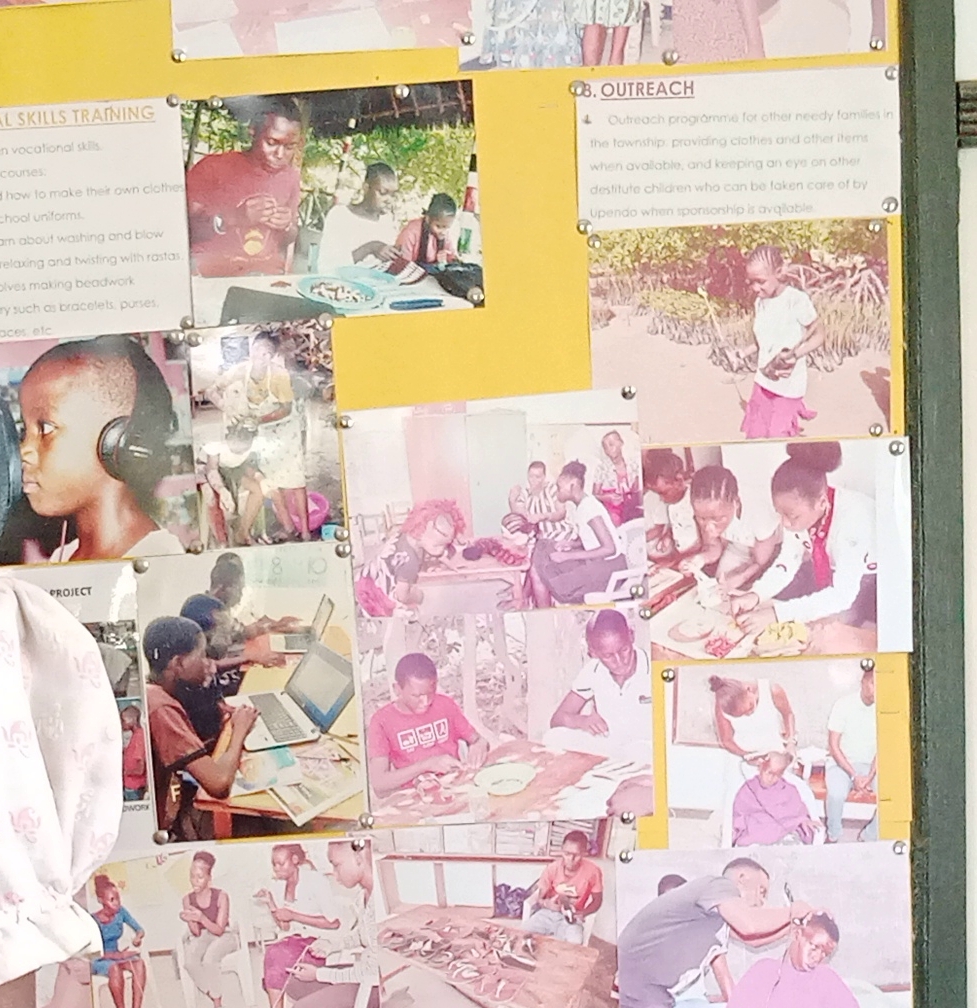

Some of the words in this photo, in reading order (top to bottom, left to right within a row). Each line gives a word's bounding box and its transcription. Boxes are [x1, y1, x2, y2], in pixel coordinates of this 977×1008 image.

[601, 81, 694, 97] OUTREACH
[18, 110, 66, 126] SKILLS
[72, 106, 155, 122] TRAINING
[608, 114, 664, 125] Outreach
[743, 112, 757, 122] for
[761, 111, 791, 121] other
[796, 110, 833, 122] needy
[837, 109, 880, 120] families
[884, 109, 893, 119] in
[590, 138, 609, 148] the
[672, 135, 727, 149] providing
[731, 135, 772, 146] clothes
[776, 134, 800, 145] and
[803, 134, 833, 144] other
[837, 133, 868, 143] items
[13, 143, 74, 155] vocational
[590, 161, 622, 171] when
[687, 159, 711, 169] and
[714, 158, 763, 170] keeping
[766, 160, 782, 168] an
[786, 158, 807, 169] eye
[811, 158, 826, 167] on
[829, 156, 860, 166] other
[6, 190, 31, 201] how
[35, 190, 46, 200] to
[50, 187, 83, 199] make
[86, 186, 110, 197] their
[114, 186, 139, 196] own
[143, 182, 184, 194] clothes
[590, 184, 640, 195] destitute
[644, 183, 692, 194] children
[695, 182, 720, 192] who
[724, 184, 747, 192] can
[751, 181, 766, 191] be
[770, 181, 803, 191] taken
[807, 181, 834, 190] care
[838, 180, 850, 189] of
[853, 180, 868, 191] by
[590, 207, 637, 219] Upendo
[641, 206, 673, 217] when
[677, 204, 744, 217] sponsorship
[747, 204, 756, 214] is
[19, 234, 54, 246] about
[57, 232, 105, 244] washing
[108, 230, 132, 241] and
[135, 229, 164, 239] blow
[0, 258, 45, 270] relaxing
[48, 257, 71, 267] and
[75, 255, 117, 266] twisting
[120, 253, 144, 263] with
[29, 278, 72, 291] making
[75, 276, 135, 288] beadwork
[13, 303, 40, 314] such
[44, 304, 56, 313] as
[49, 586, 92, 598] PROJECT
